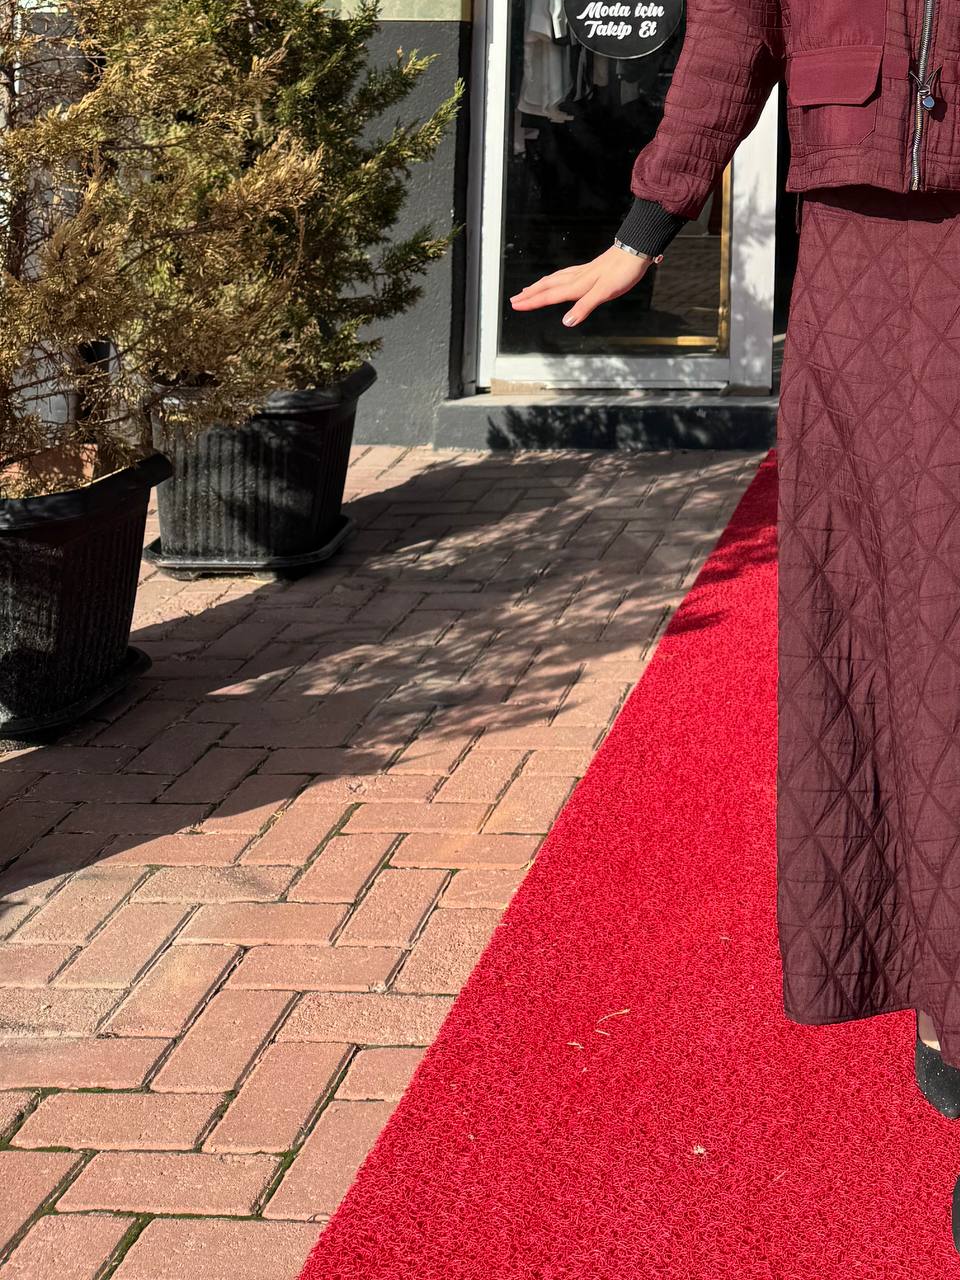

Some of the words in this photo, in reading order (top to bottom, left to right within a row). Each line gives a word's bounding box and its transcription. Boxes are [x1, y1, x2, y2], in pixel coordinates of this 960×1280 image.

[576, 1, 632, 20] Moda
[634, 2, 665, 19] için
[584, 20, 632, 40] Takip
[638, 20, 658, 39] Et
